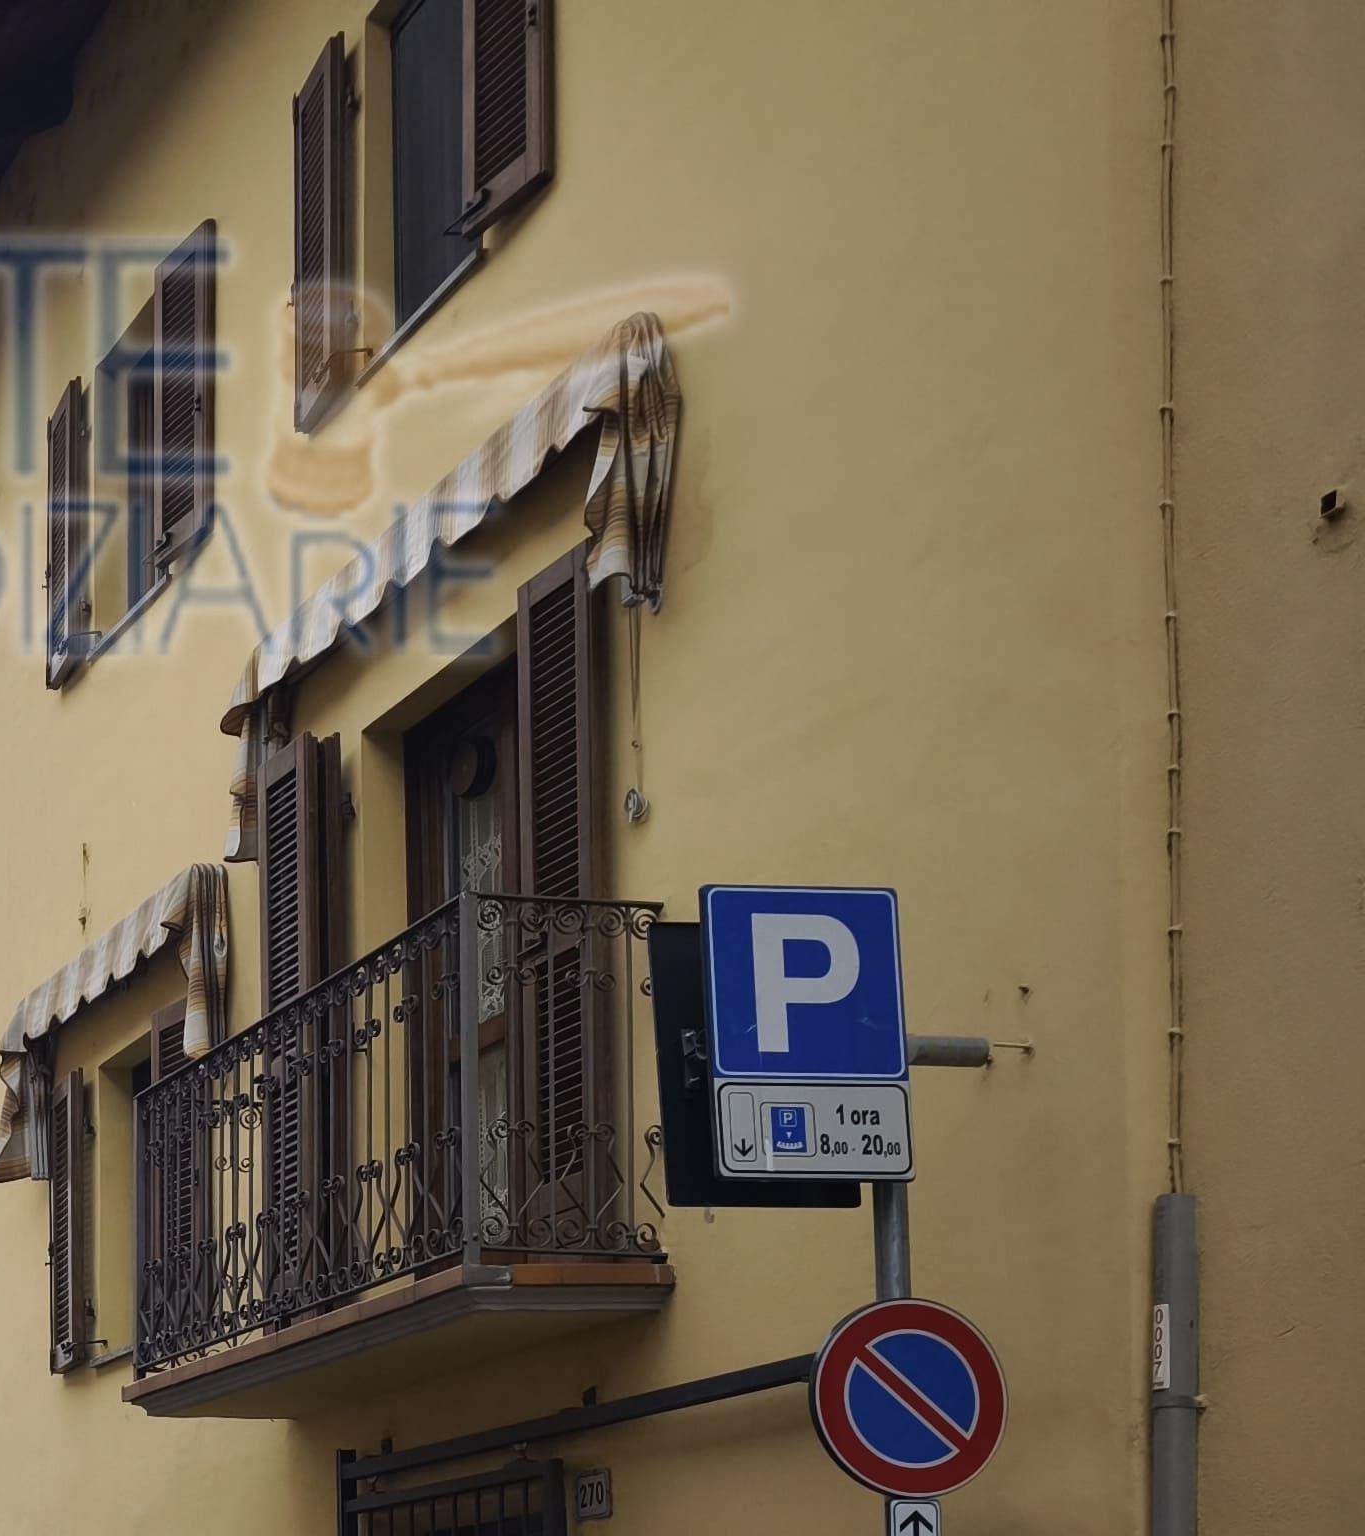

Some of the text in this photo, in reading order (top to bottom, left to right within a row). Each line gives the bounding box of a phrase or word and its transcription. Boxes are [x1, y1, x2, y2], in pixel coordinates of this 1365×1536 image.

[751, 913, 860, 1052] P
[783, 1112, 793, 1124] P
[836, 1104, 880, 1125] 1 ora
[820, 1133, 848, 1157] 8,00
[861, 1134, 901, 1158] 20,00
[580, 1481, 604, 1508] 270
